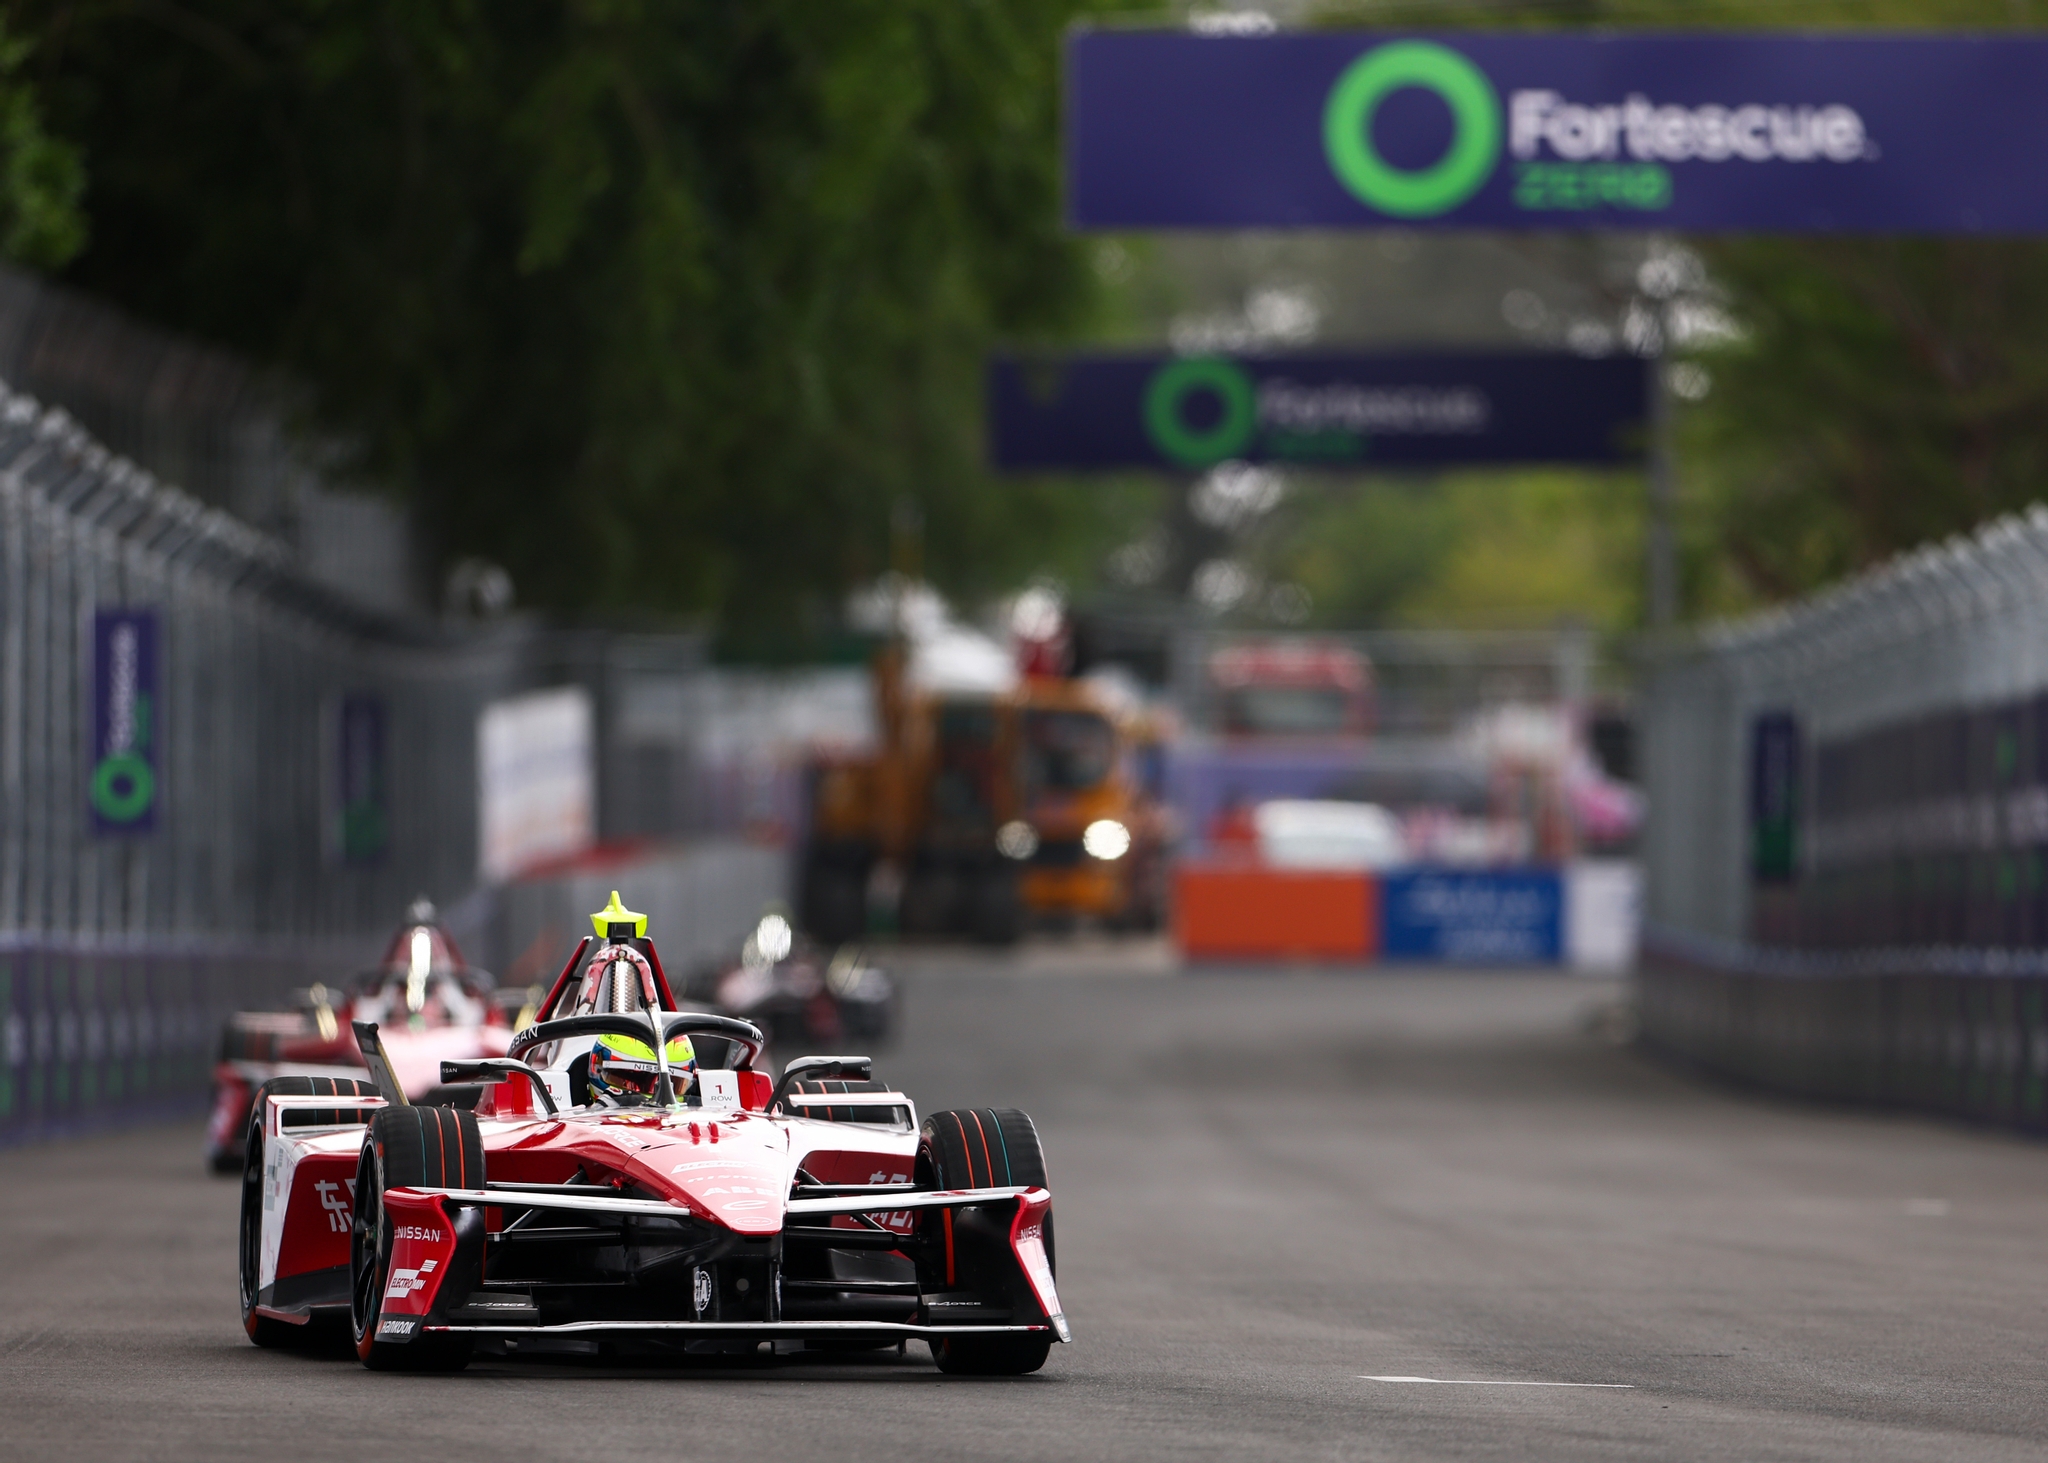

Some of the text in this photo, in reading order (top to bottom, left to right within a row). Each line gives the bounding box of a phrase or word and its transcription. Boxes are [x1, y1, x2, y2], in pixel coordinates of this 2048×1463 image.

[1511, 90, 1863, 159] Fortescue
[715, 1084, 724, 1095] 1
[397, 1226, 440, 1242] NISSAN
